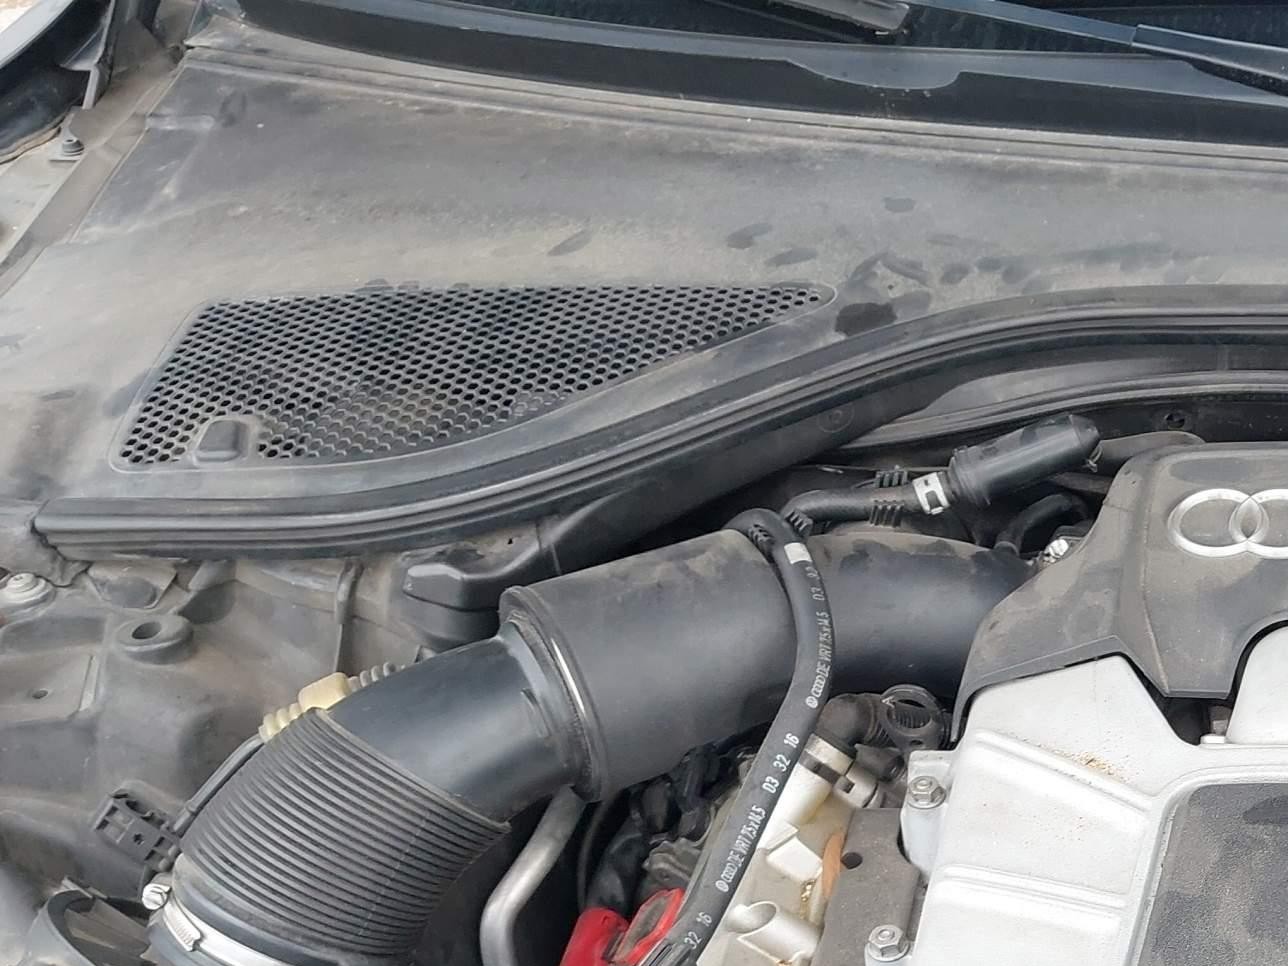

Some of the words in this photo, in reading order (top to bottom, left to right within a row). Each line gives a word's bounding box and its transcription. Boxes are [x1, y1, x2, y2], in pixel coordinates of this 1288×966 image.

[816, 661, 830, 676] DE
[727, 851, 744, 866] DE
[762, 776, 779, 793] 03
[773, 754, 790, 771] 32
[784, 733, 799, 747] 16
[684, 931, 701, 949] 32
[696, 912, 711, 926] 16
